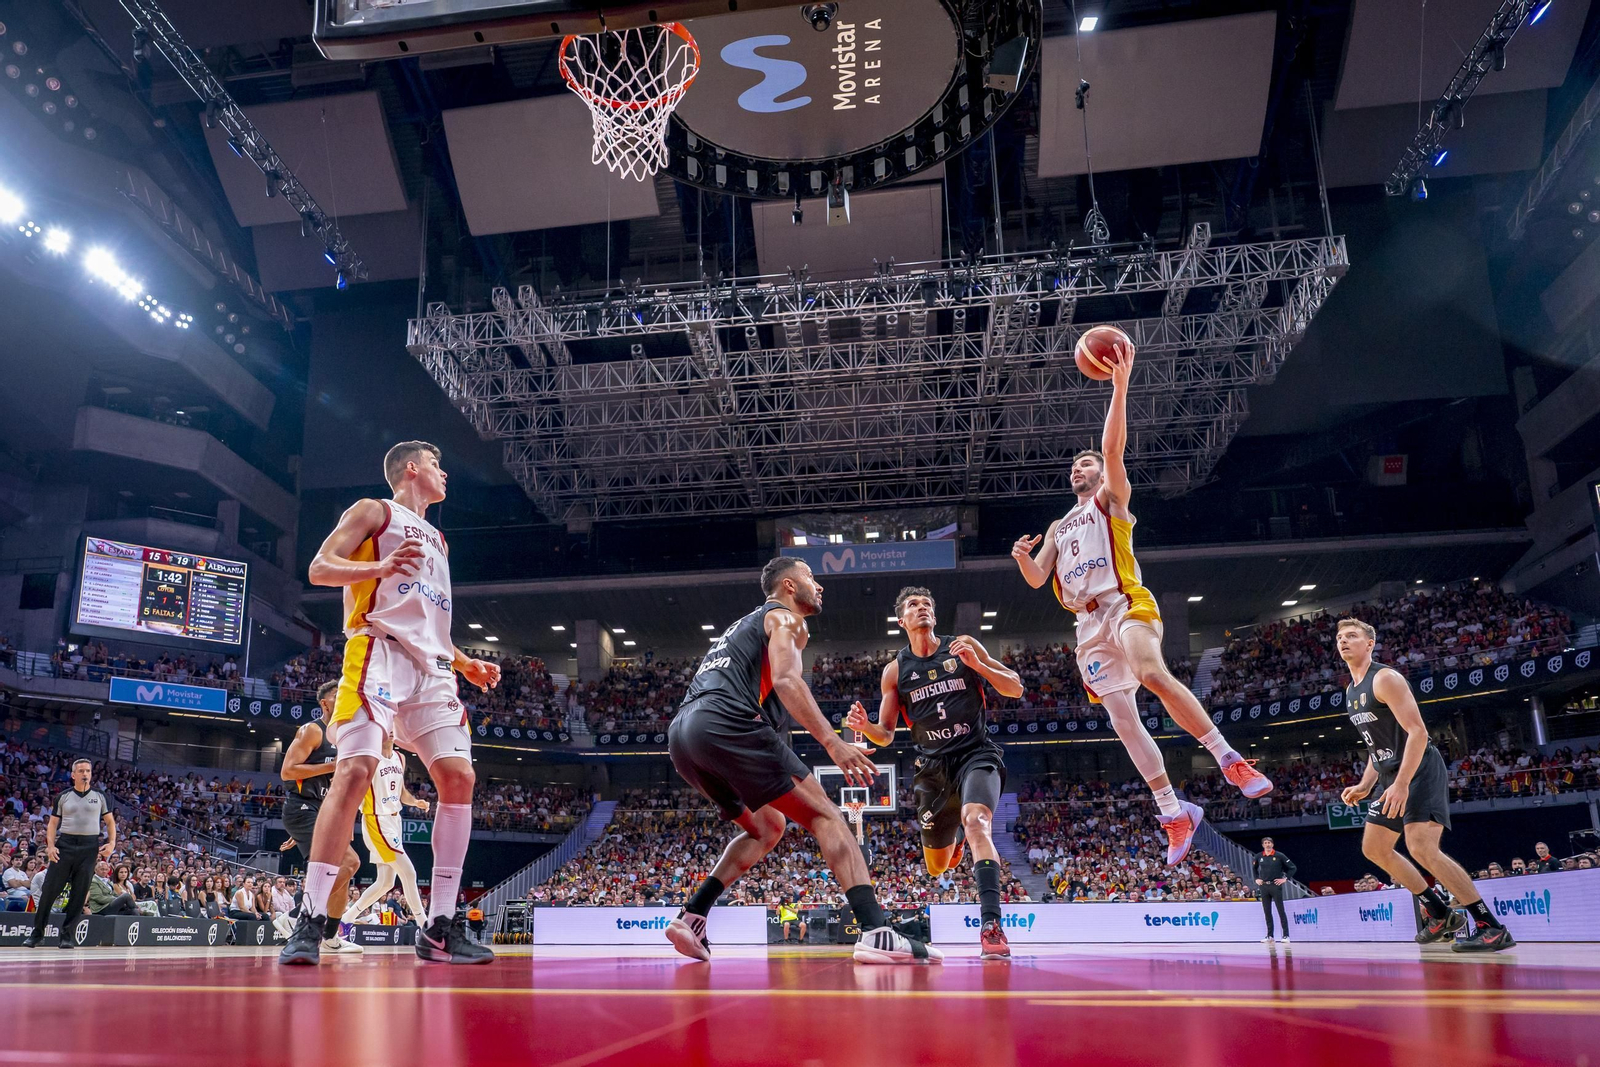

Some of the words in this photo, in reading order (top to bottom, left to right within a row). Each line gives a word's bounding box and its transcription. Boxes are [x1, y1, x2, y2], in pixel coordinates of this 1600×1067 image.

[830, 20, 857, 110] Movistar
[864, 18, 882, 104] ARENA
[860, 550, 907, 560] Movistar
[1070, 539, 1080, 557] 8
[149, 551, 161, 560] 15
[177, 556, 189, 565] 19
[861, 560, 906, 569] ARENA
[207, 562, 244, 574] ALEMANIA
[426, 557, 434, 576] 4
[1064, 557, 1108, 584] endesa
[157, 570, 183, 584] 1:42
[162, 596, 168, 605] 1
[398, 581, 451, 612] endesa
[144, 607, 150, 616] 5
[152, 608, 175, 618] FALTAS
[177, 611, 183, 620] 4
[166, 688, 203, 699] Movistar
[909, 678, 967, 703] DEUTSCHLAND
[166, 697, 202, 705] ARENA
[936, 702, 947, 720] 5
[925, 728, 952, 741] ING
[390, 780, 396, 791] 6
[1331, 804, 1369, 818] SAL
[403, 821, 428, 833] IDA
[1493, 888, 1552, 923] tenerife!
[1143, 911, 1219, 931] tenerife!
[1293, 907, 1318, 929] tenerife!
[1359, 901, 1393, 927] tenerife!
[963, 912, 1036, 932] terife!
[151, 925, 176, 934] SELECCIÓN
[176, 926, 198, 934] ESPAÑOLA
